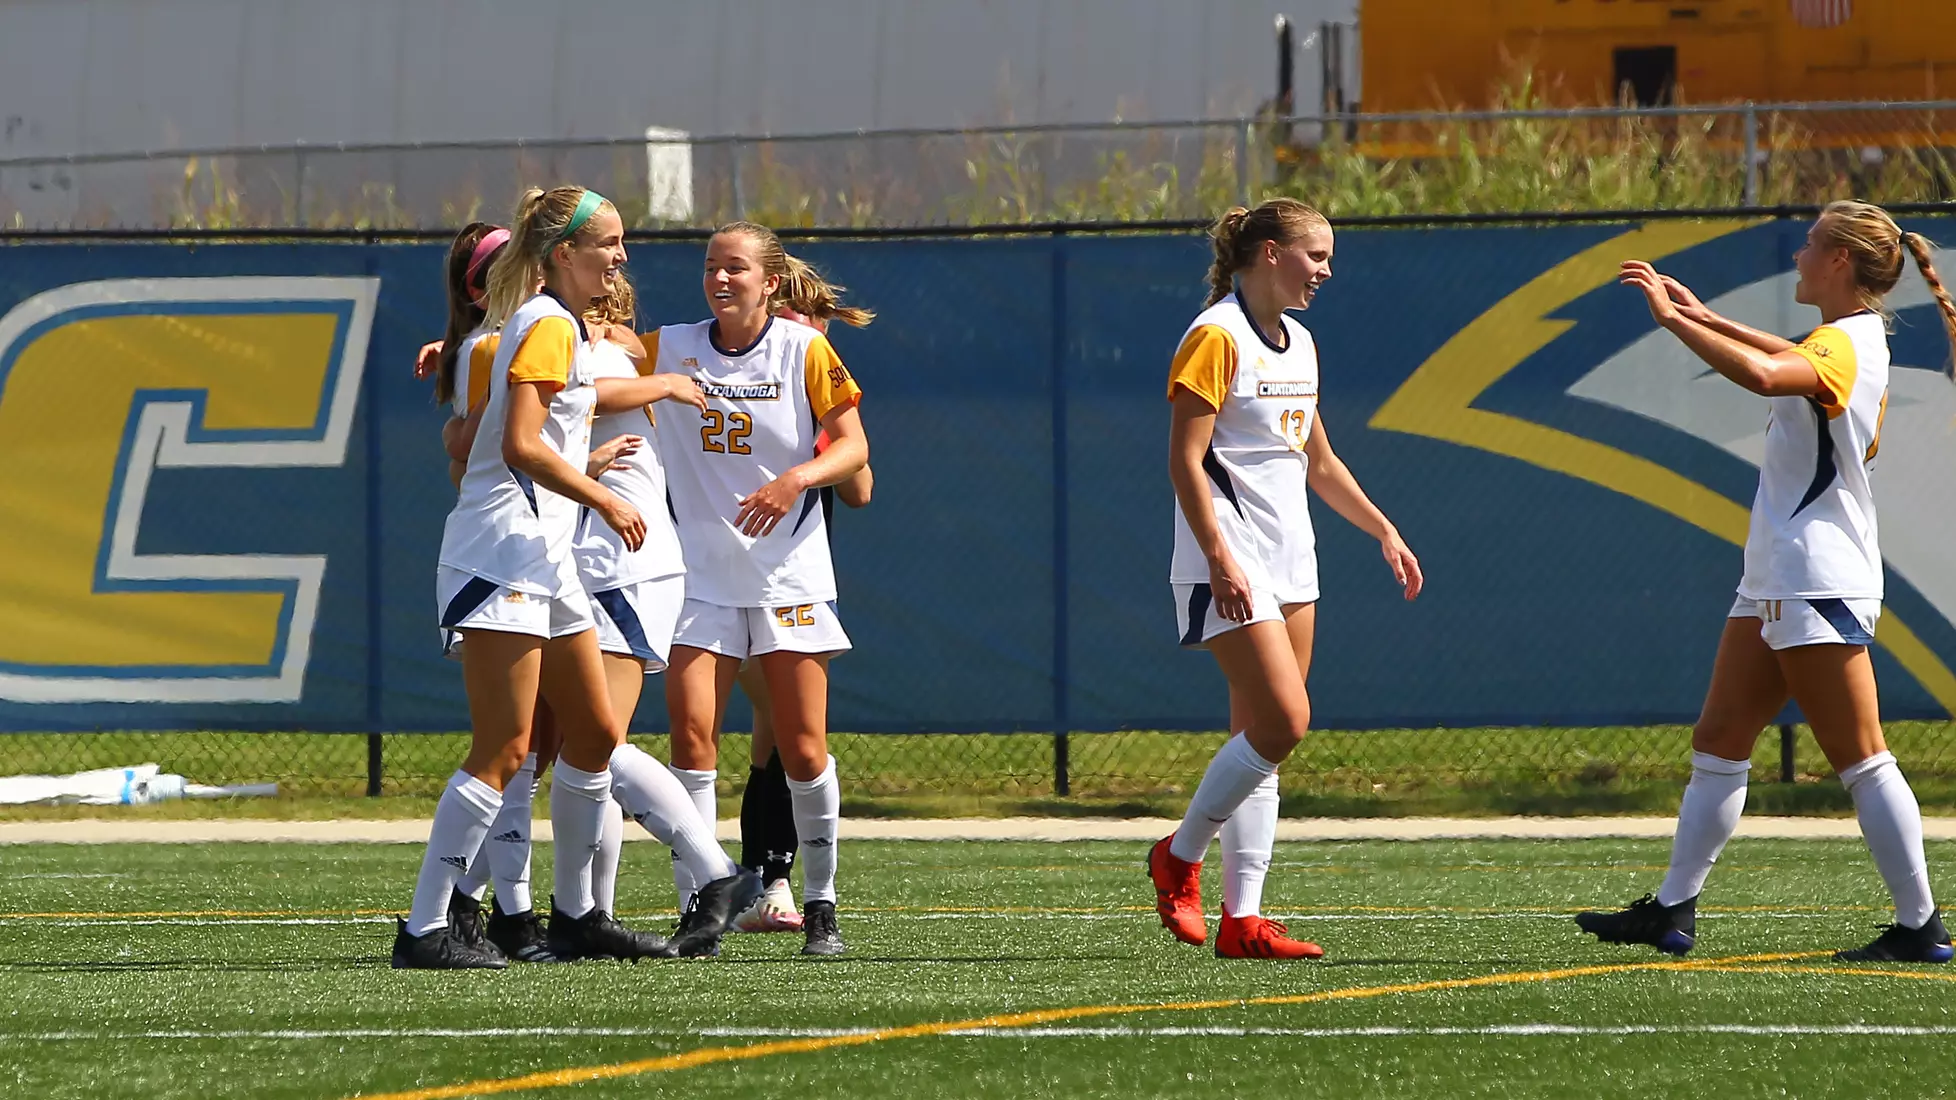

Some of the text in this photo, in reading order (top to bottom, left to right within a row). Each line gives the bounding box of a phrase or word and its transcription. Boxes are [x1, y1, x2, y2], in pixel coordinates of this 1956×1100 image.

[701, 409, 753, 455] 22
[1280, 409, 1306, 453] 13
[0, 275, 381, 703] C
